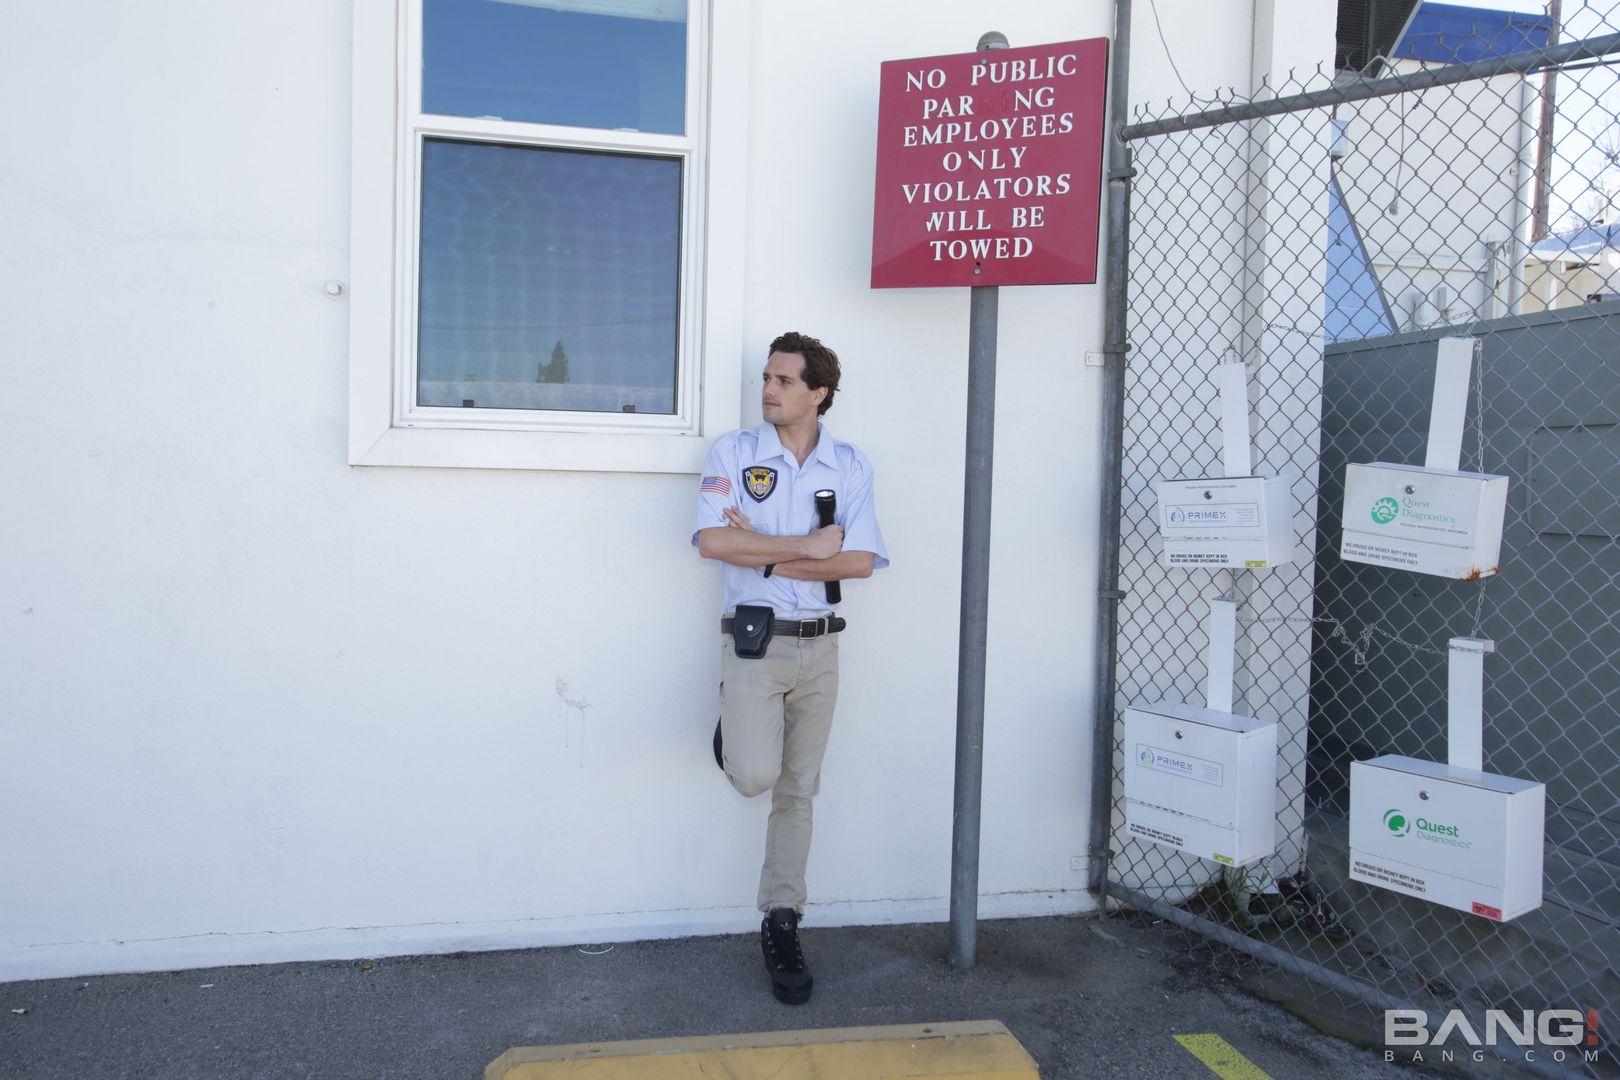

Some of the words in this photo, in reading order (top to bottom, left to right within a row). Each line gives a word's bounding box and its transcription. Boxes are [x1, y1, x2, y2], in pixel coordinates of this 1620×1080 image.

[905, 68, 947, 93] NO
[970, 54, 1077, 86] PUBLIC
[922, 86, 1056, 120] PARNG
[903, 111, 1074, 148] EMPLOYEES
[942, 146, 1028, 172] ONLY
[901, 173, 1072, 205] VIOLATORS
[925, 209, 991, 233] WILL
[1011, 205, 1045, 229] BE
[929, 236, 1034, 262] TOWED
[1187, 511, 1227, 519] PRIMEX
[1402, 497, 1431, 509] Quest
[1402, 508, 1456, 524] Diagnostics
[1157, 756, 1192, 771] PRIMEX
[1416, 818, 1460, 838] Quest
[1416, 830, 1470, 850] Diagnostics
